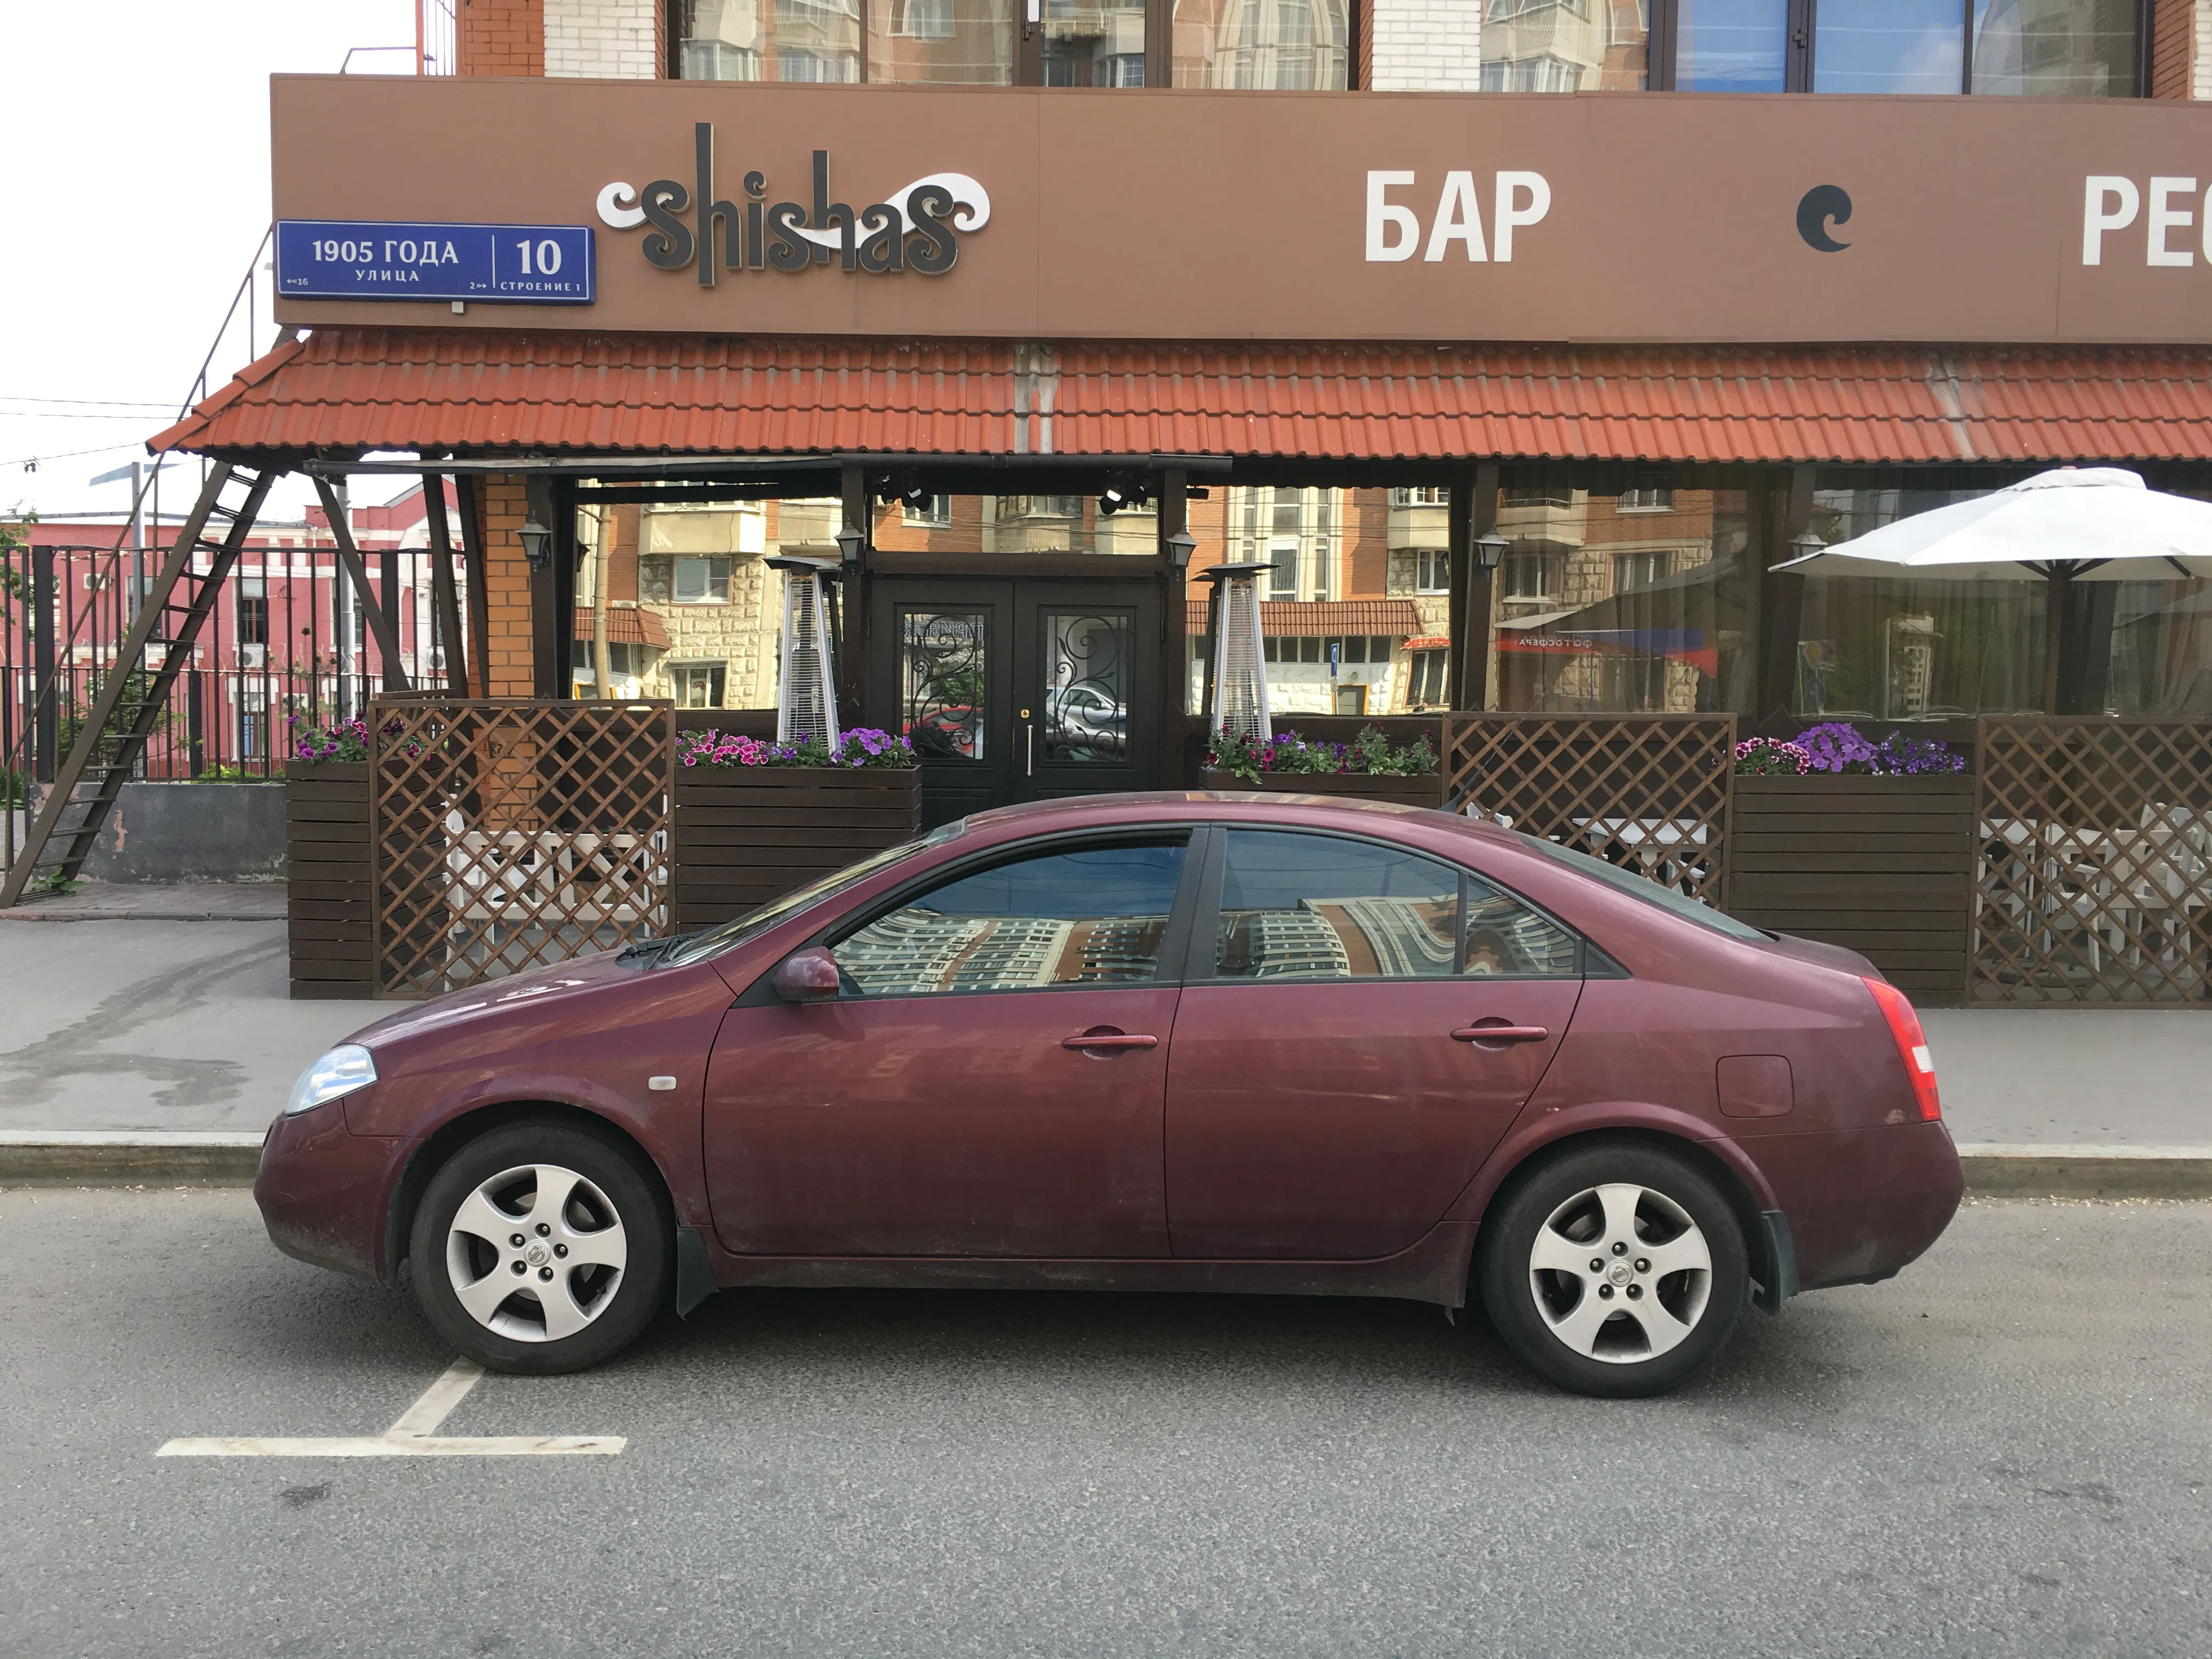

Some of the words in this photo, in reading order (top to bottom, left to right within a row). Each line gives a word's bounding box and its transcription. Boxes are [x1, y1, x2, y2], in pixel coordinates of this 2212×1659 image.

[641, 122, 958, 287] shishas
[1366, 171, 1551, 262] БАР
[2083, 176, 2212, 267] РЕ
[312, 240, 374, 263] 1905
[385, 240, 459, 267] ГОДА
[516, 240, 562, 275] 10
[355, 270, 419, 283] УЛИЦА
[500, 281, 571, 291] СТРОЕНИЕ
